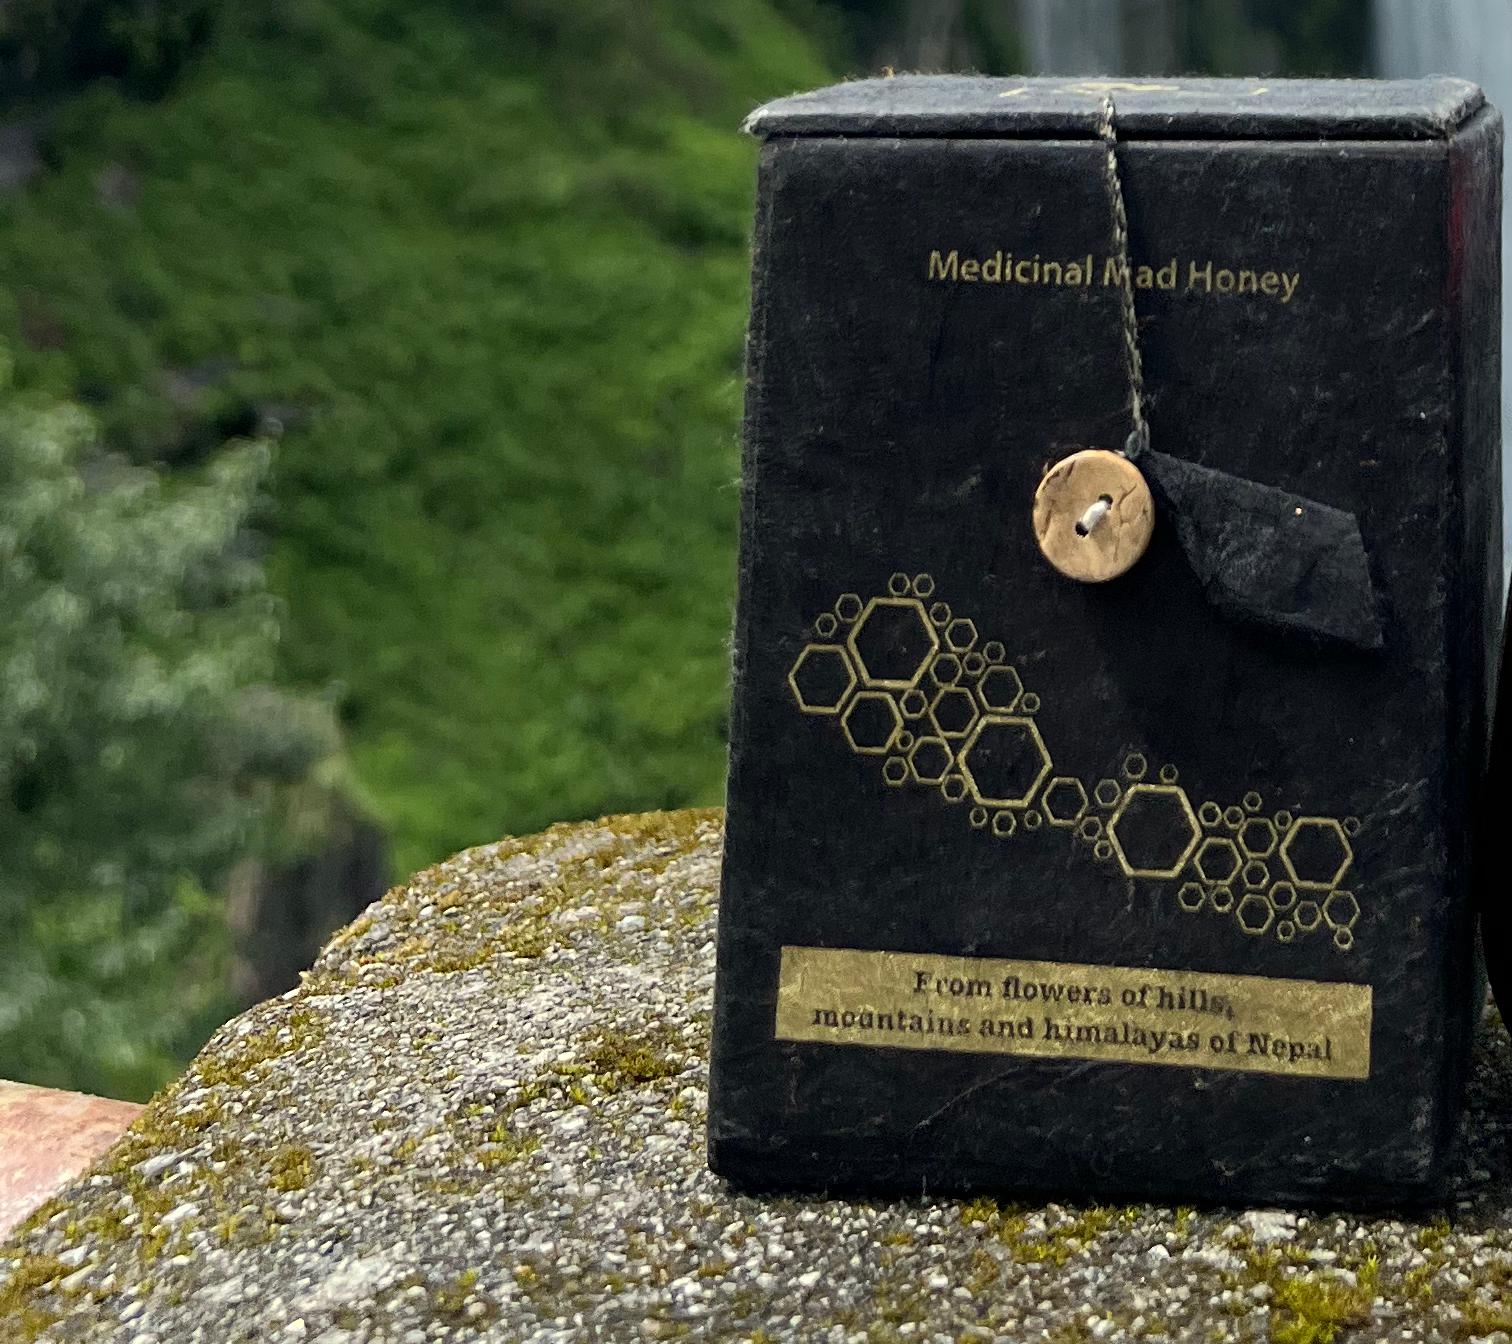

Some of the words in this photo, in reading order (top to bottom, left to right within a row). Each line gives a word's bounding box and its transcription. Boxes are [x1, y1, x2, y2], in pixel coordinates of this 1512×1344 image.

[928, 249, 1093, 286] Medicinal
[1103, 257, 1177, 290] Mad
[1188, 260, 1300, 303] Honey
[913, 970, 993, 998] From
[1002, 975, 1111, 1006] flowers
[1121, 984, 1151, 1007] of
[812, 1009, 971, 1036] mountains
[979, 1016, 1034, 1040] and
[1043, 1017, 1201, 1054] himalayas
[1209, 1030, 1243, 1054] of
[1248, 1032, 1332, 1062] Nepal
